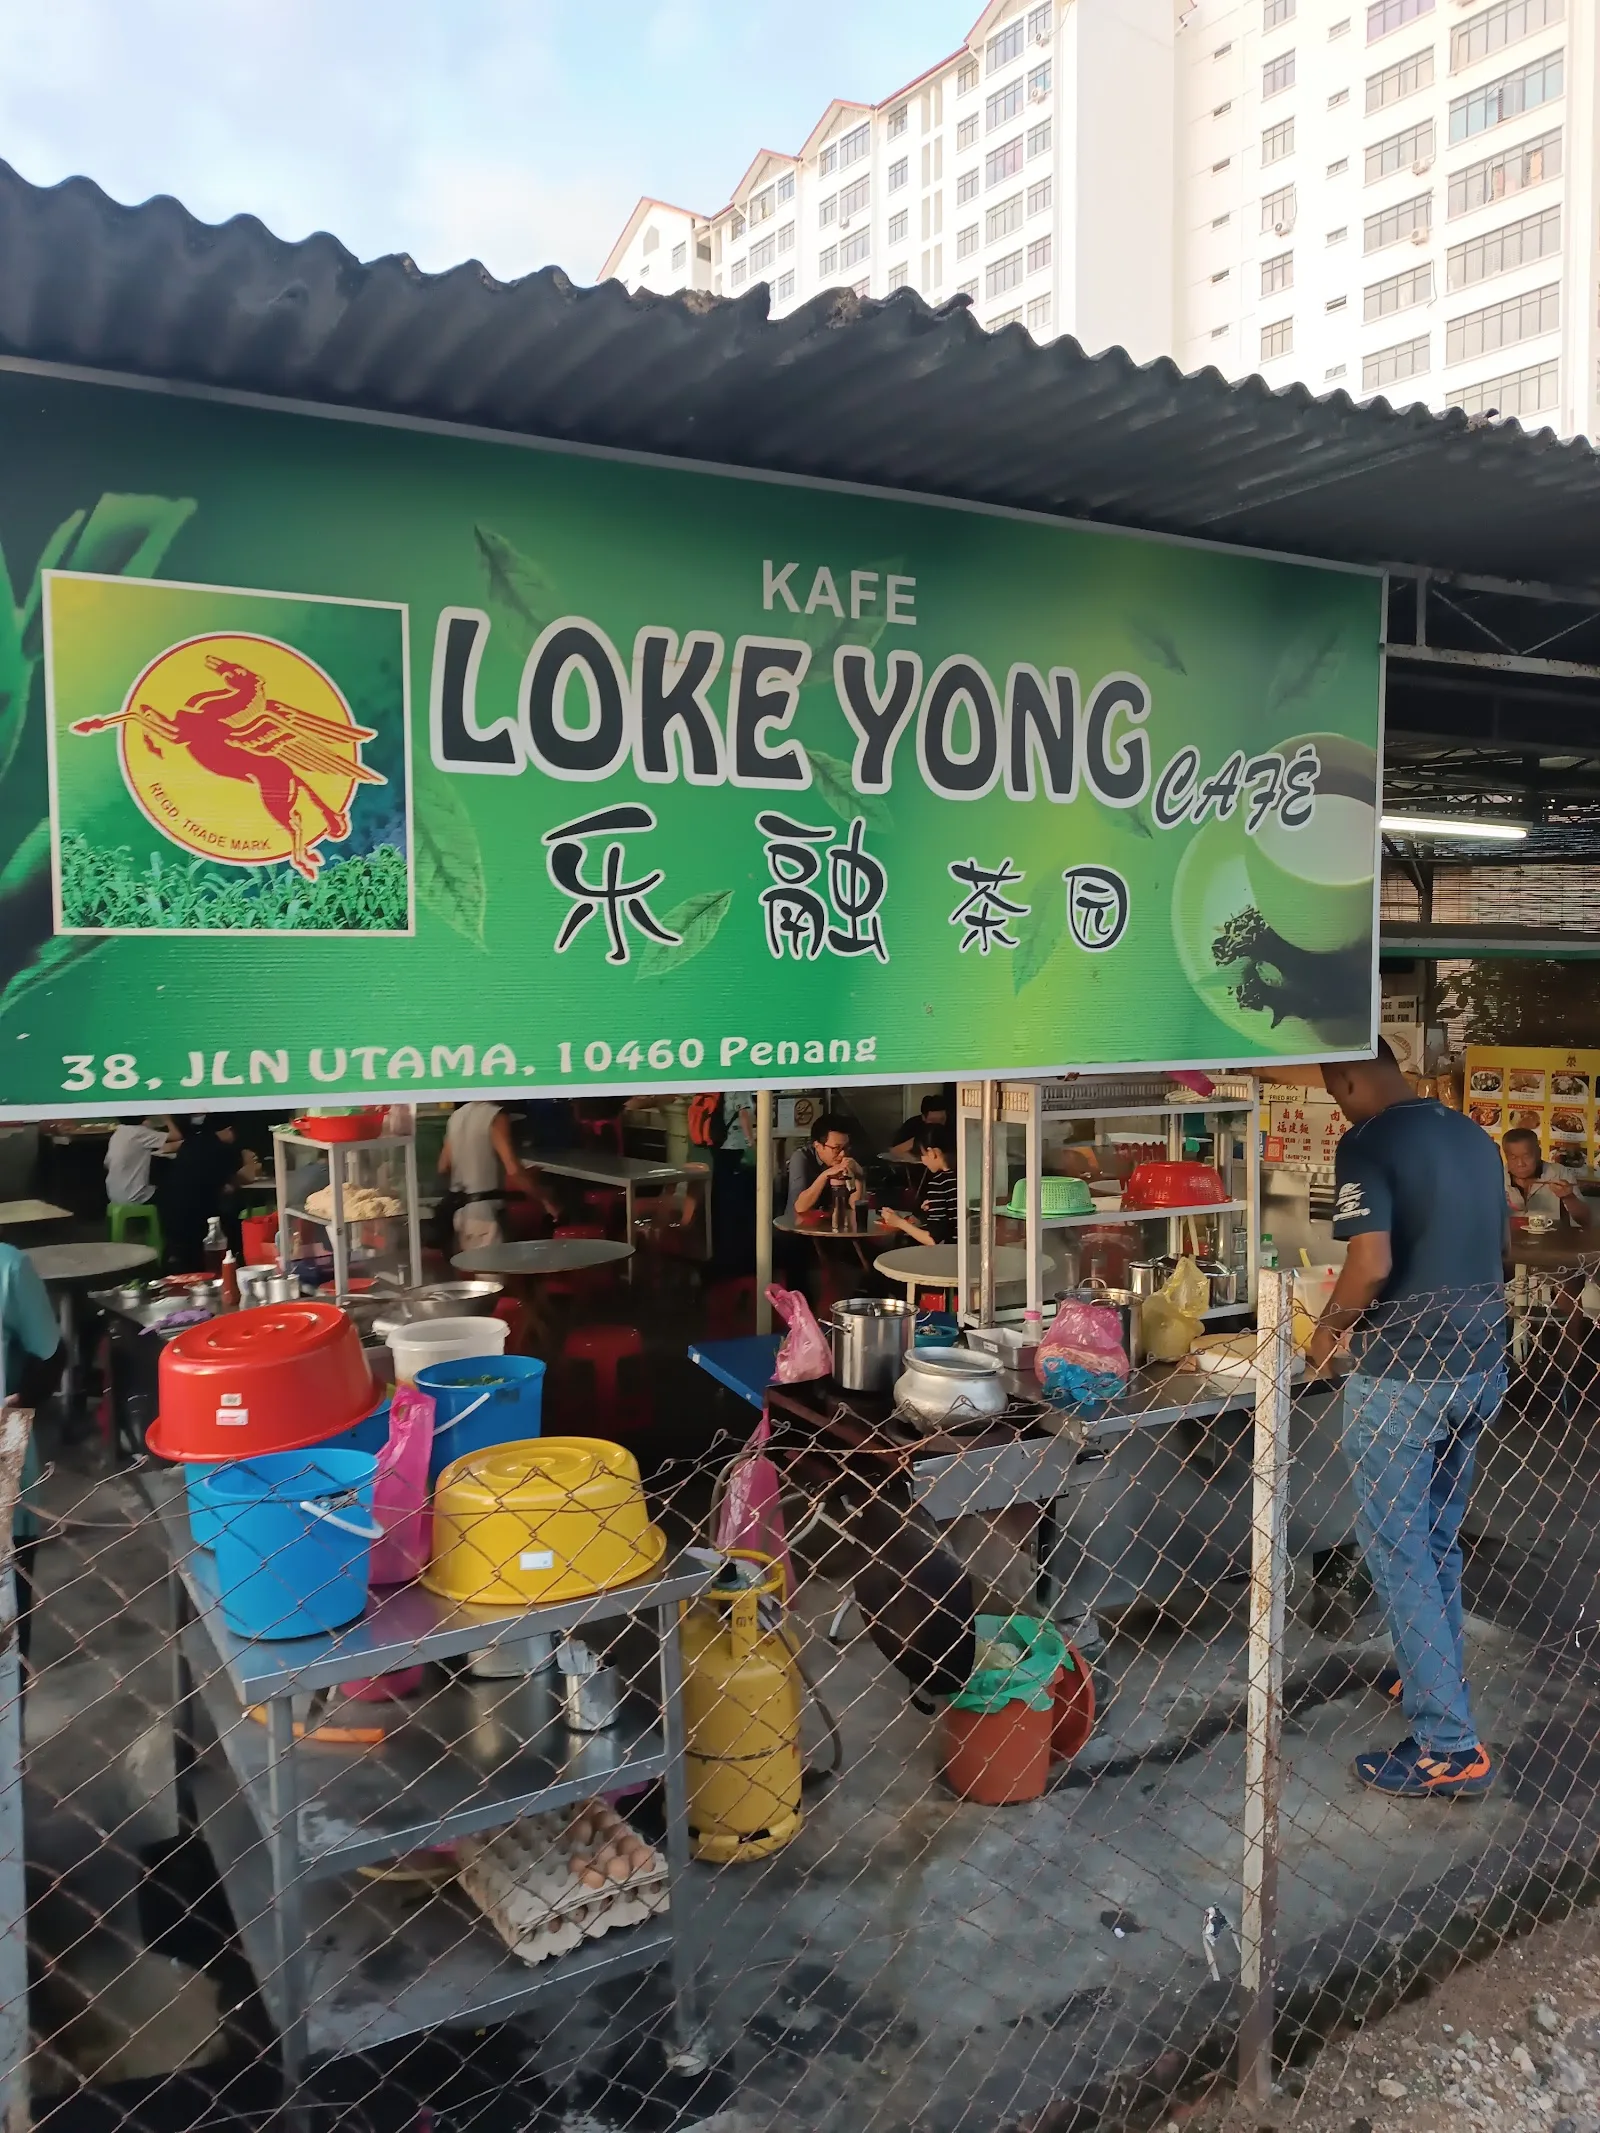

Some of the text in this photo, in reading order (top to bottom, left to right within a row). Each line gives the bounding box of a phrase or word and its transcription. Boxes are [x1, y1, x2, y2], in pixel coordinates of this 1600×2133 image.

[762, 559, 918, 626] KAFE
[429, 606, 813, 791] LOKE
[833, 645, 1152, 808] YONG
[182, 818, 228, 848] TRADE
[229, 838, 272, 851] MARK
[60, 1035, 879, 1092] 38, JLN UTAMA, 10460 Penang
